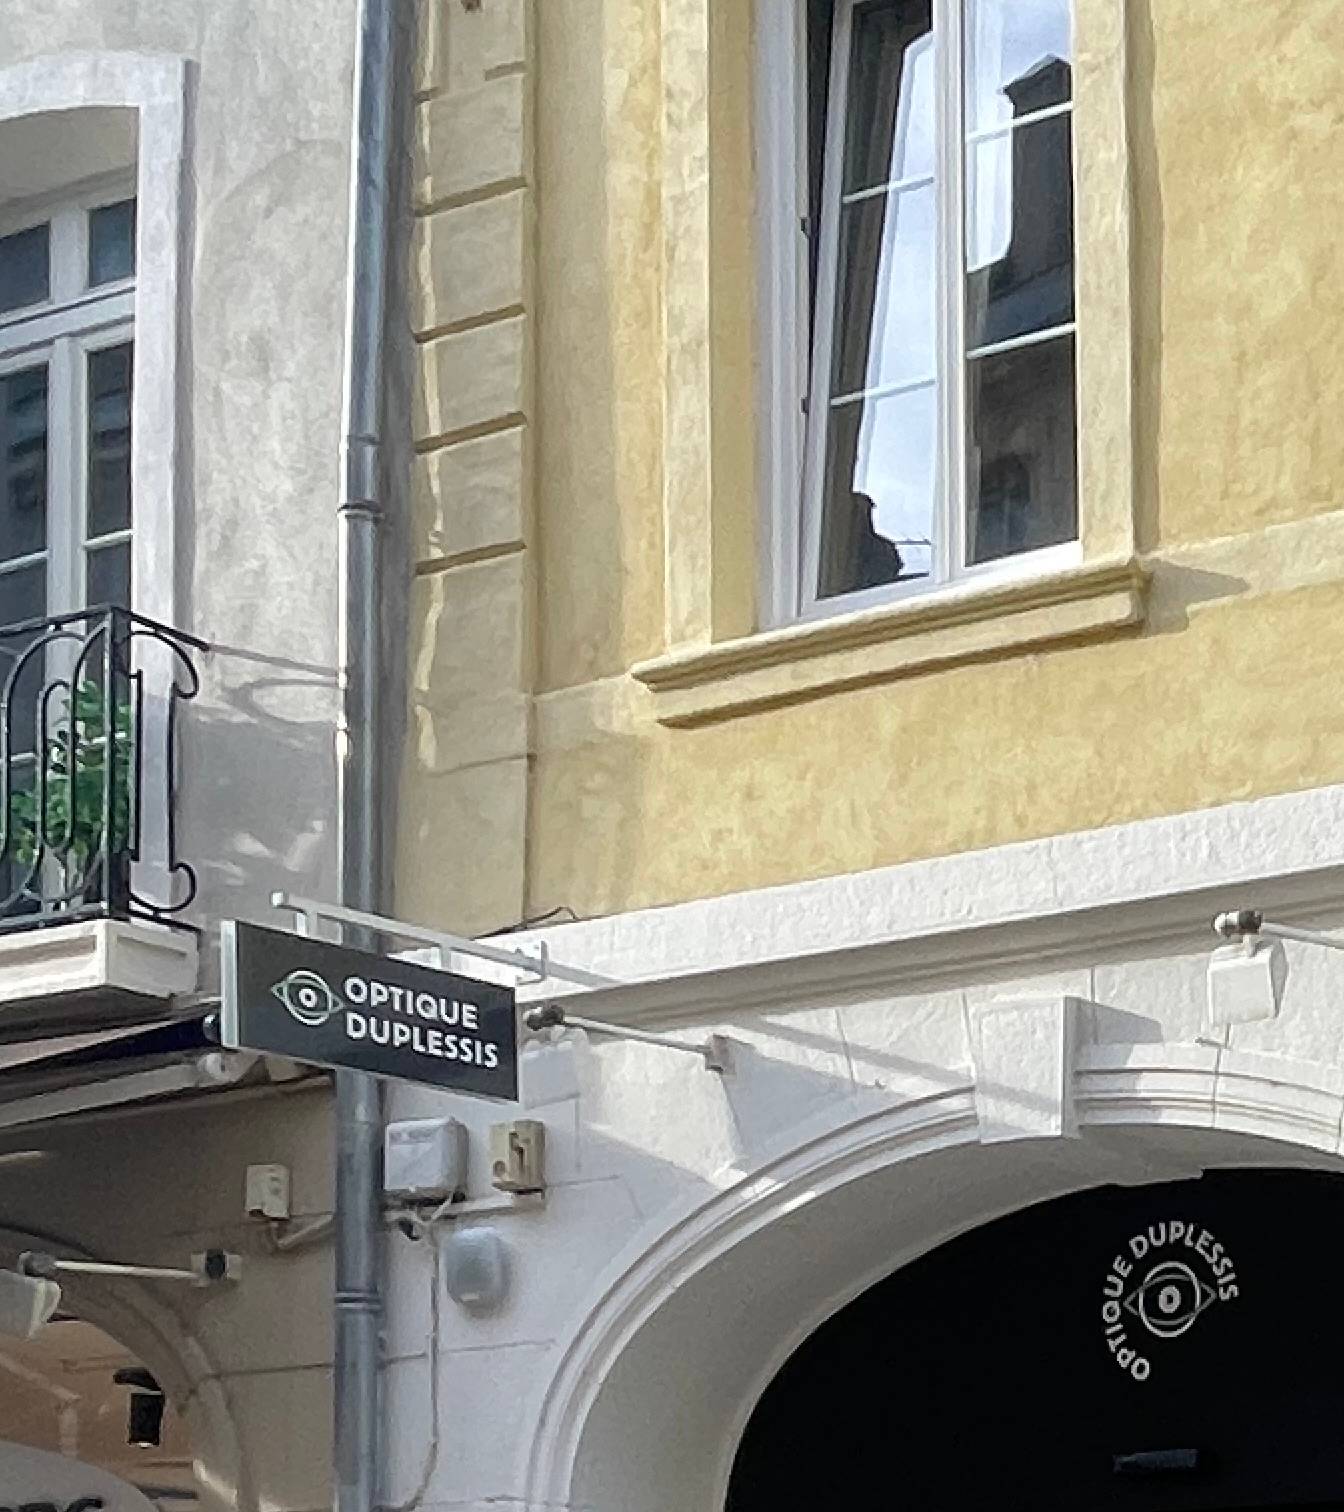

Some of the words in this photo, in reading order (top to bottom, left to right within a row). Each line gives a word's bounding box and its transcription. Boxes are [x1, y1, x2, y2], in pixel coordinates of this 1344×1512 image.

[344, 976, 479, 1030] OPTIQUE
[346, 1012, 499, 1068] DUPLESSIS
[1102, 1255, 1151, 1382] OPTIQUE
[1128, 1220, 1240, 1301] DUPLESSIS
